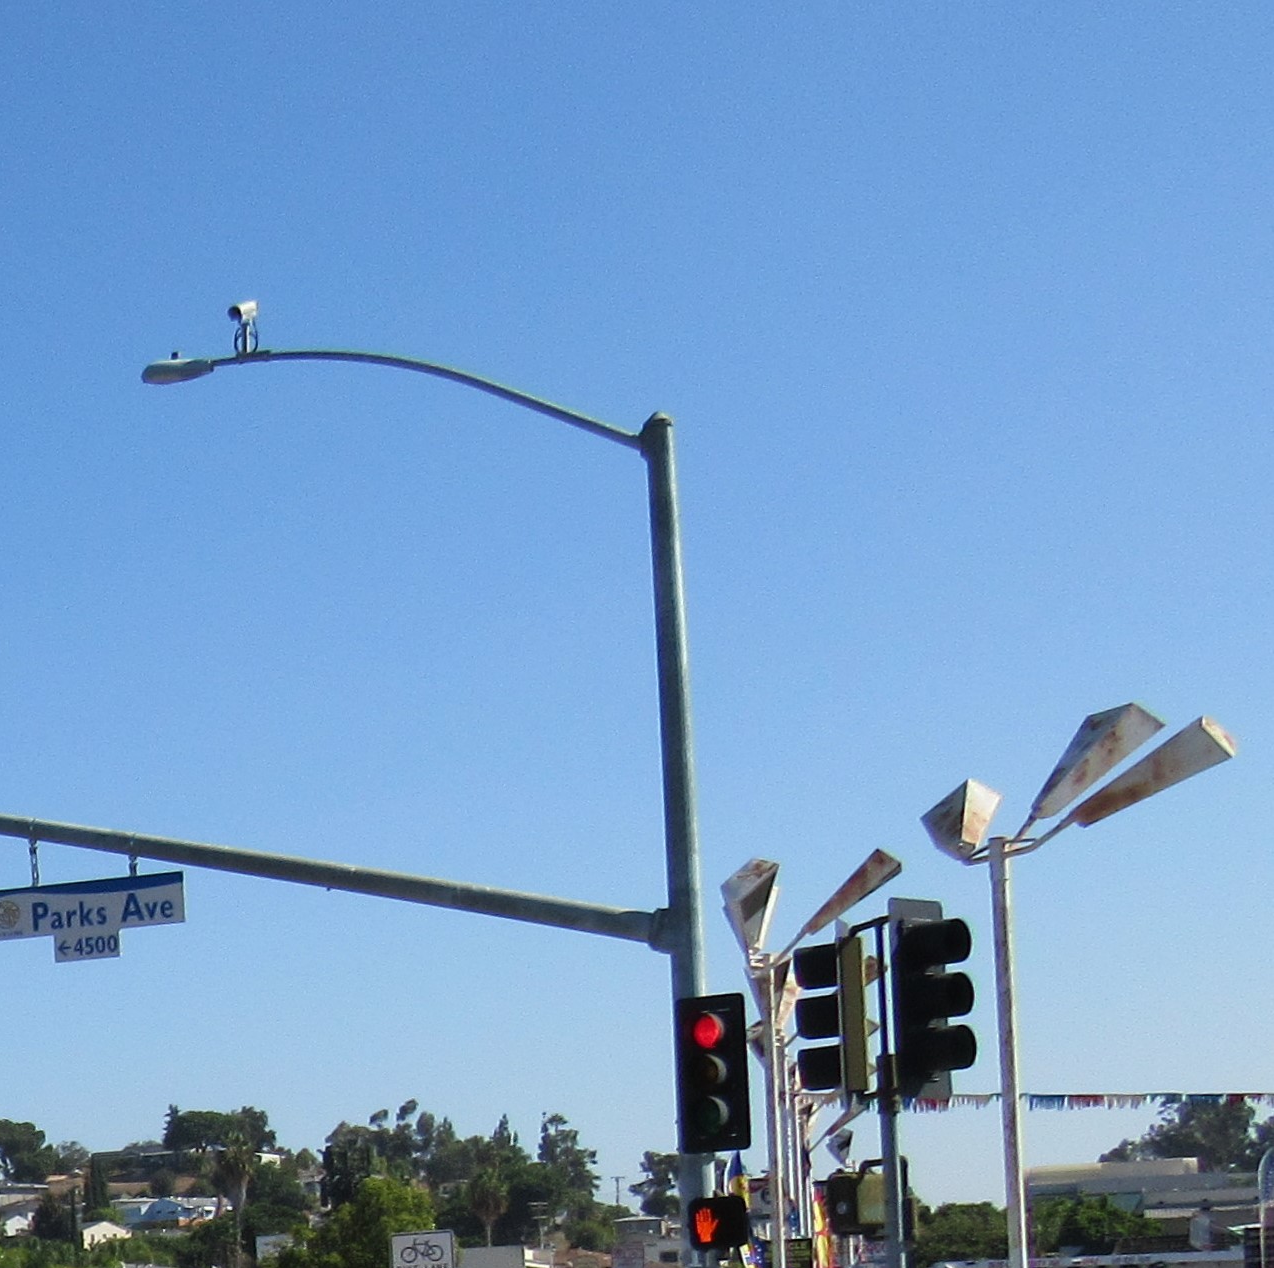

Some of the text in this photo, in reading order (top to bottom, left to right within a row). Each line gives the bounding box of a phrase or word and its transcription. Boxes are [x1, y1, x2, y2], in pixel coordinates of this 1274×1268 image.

[31, 892, 174, 932] Parks Ave
[73, 935, 118, 957] 4500
